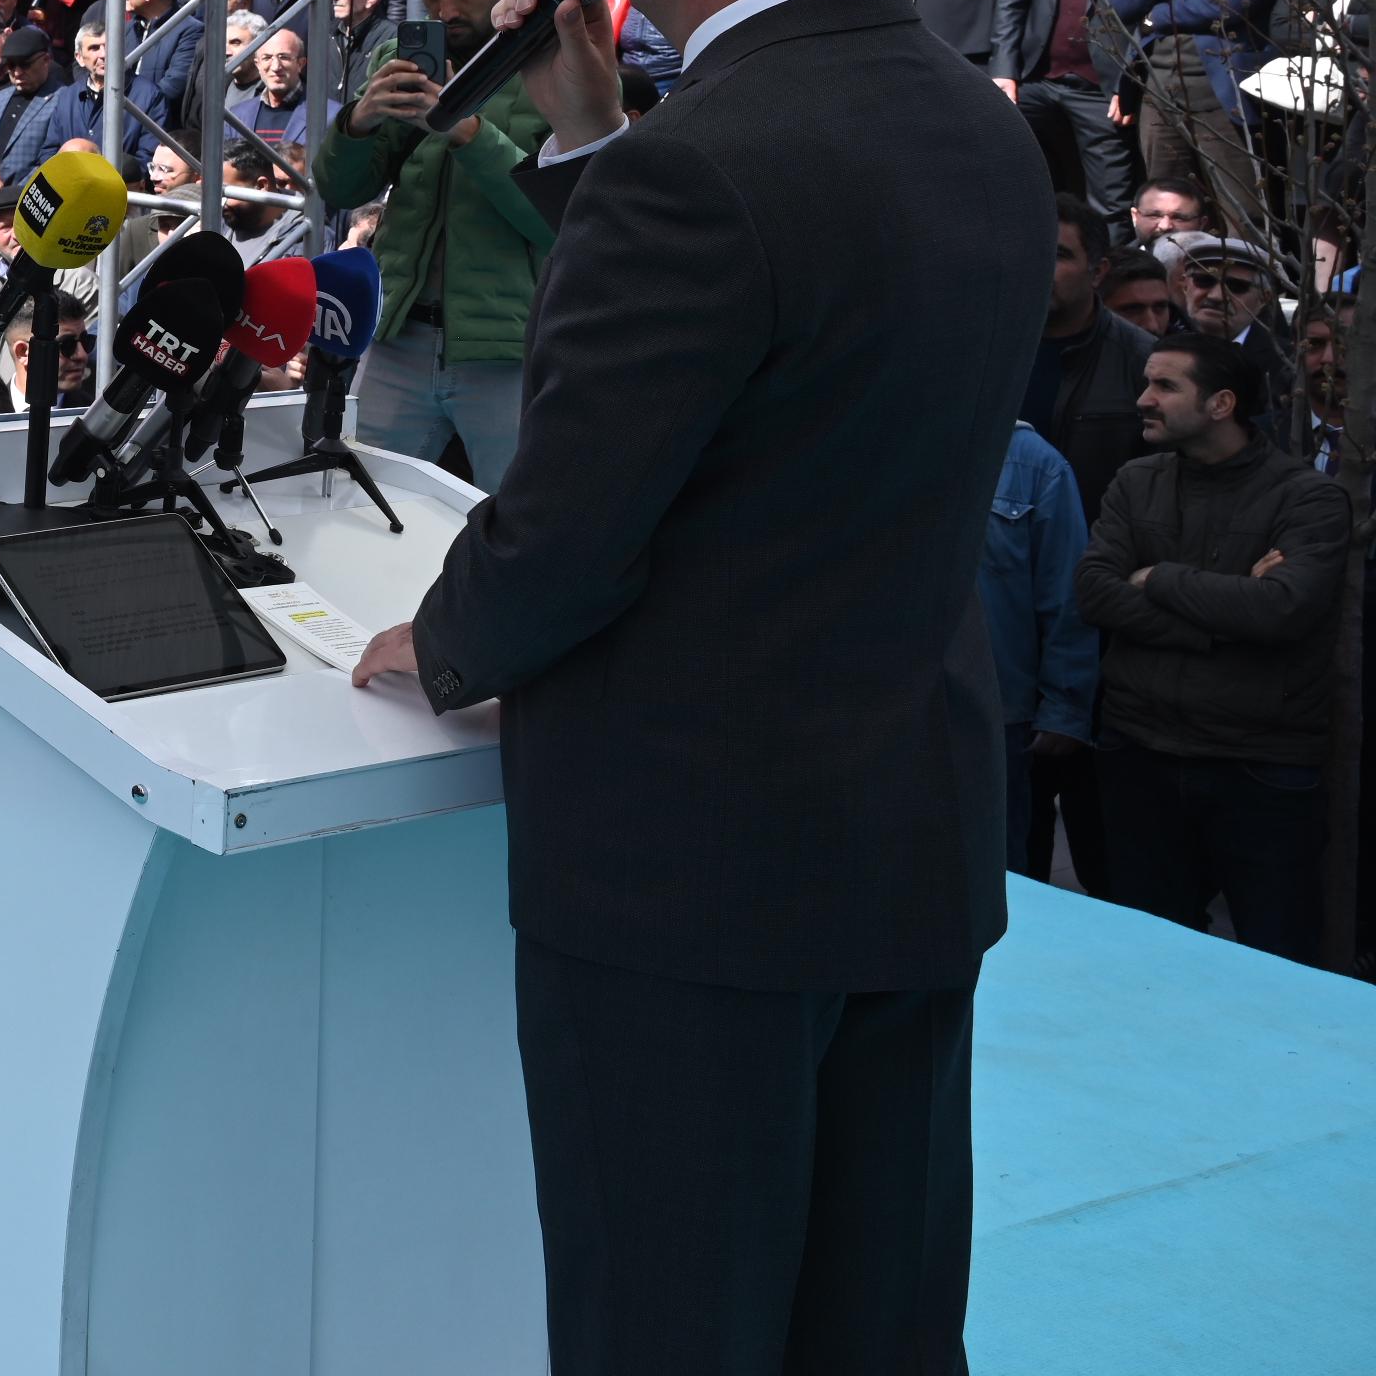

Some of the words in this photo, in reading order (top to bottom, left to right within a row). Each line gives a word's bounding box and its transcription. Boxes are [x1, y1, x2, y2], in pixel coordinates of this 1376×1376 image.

[22, 194, 48, 227] ŞEHRİM
[28, 182, 55, 217] BENİM
[133, 335, 188, 375] HABER
[144, 318, 200, 363] TRT
